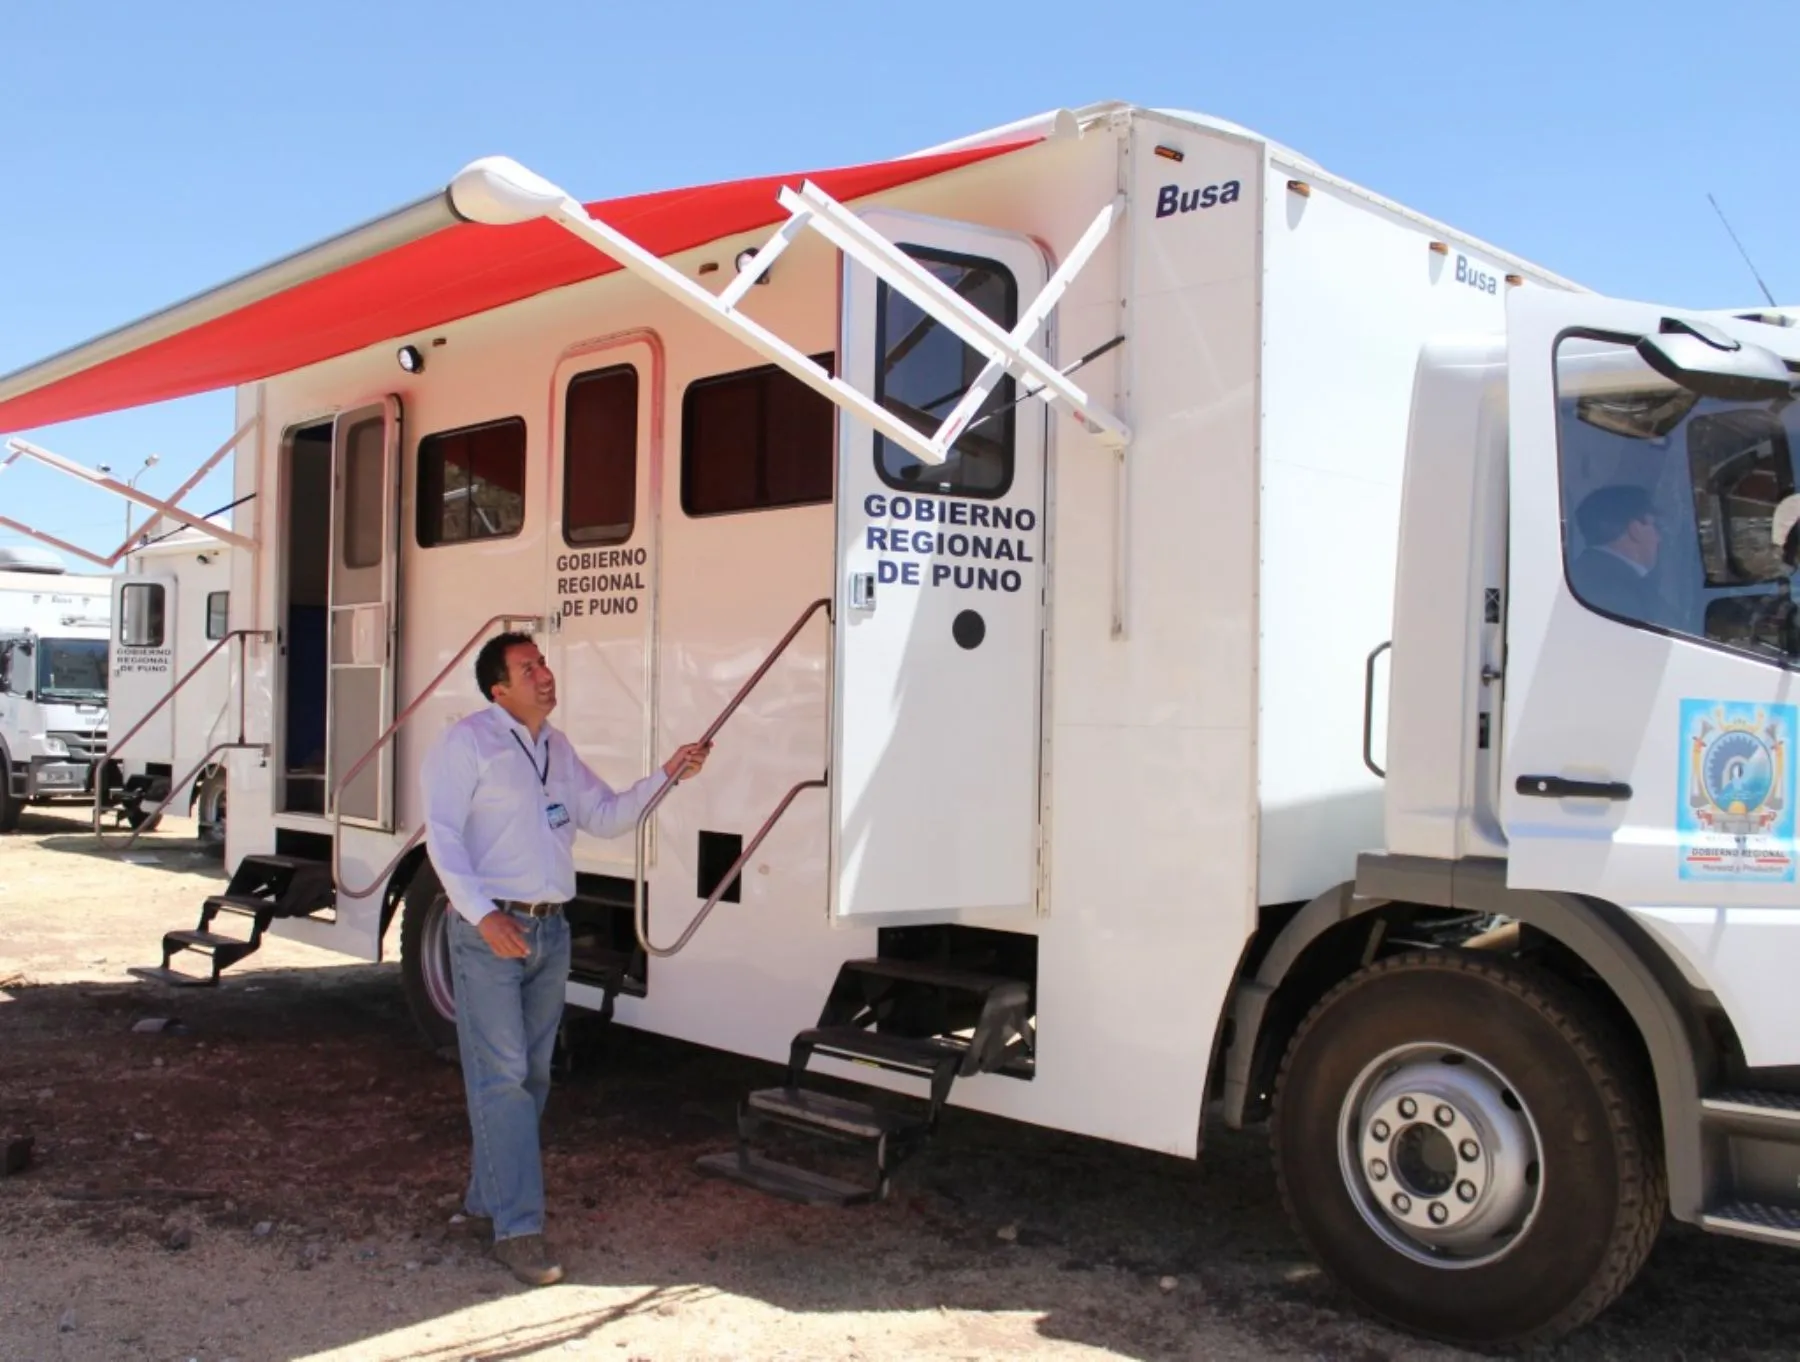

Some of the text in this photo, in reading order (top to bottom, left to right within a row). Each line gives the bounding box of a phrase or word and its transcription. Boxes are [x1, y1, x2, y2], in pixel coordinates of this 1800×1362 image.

[1155, 179, 1241, 219] Busa
[1455, 254, 1497, 296] Busa
[863, 494, 1036, 531] GOBIERNO
[556, 547, 647, 572] GOBIERNO
[866, 526, 1033, 562] REGIONAL
[557, 571, 645, 595] REGIONAL
[878, 560, 1022, 592] DE PUNO
[562, 596, 639, 618] DE PUNO
[116, 656, 168, 664] REGIONAL
